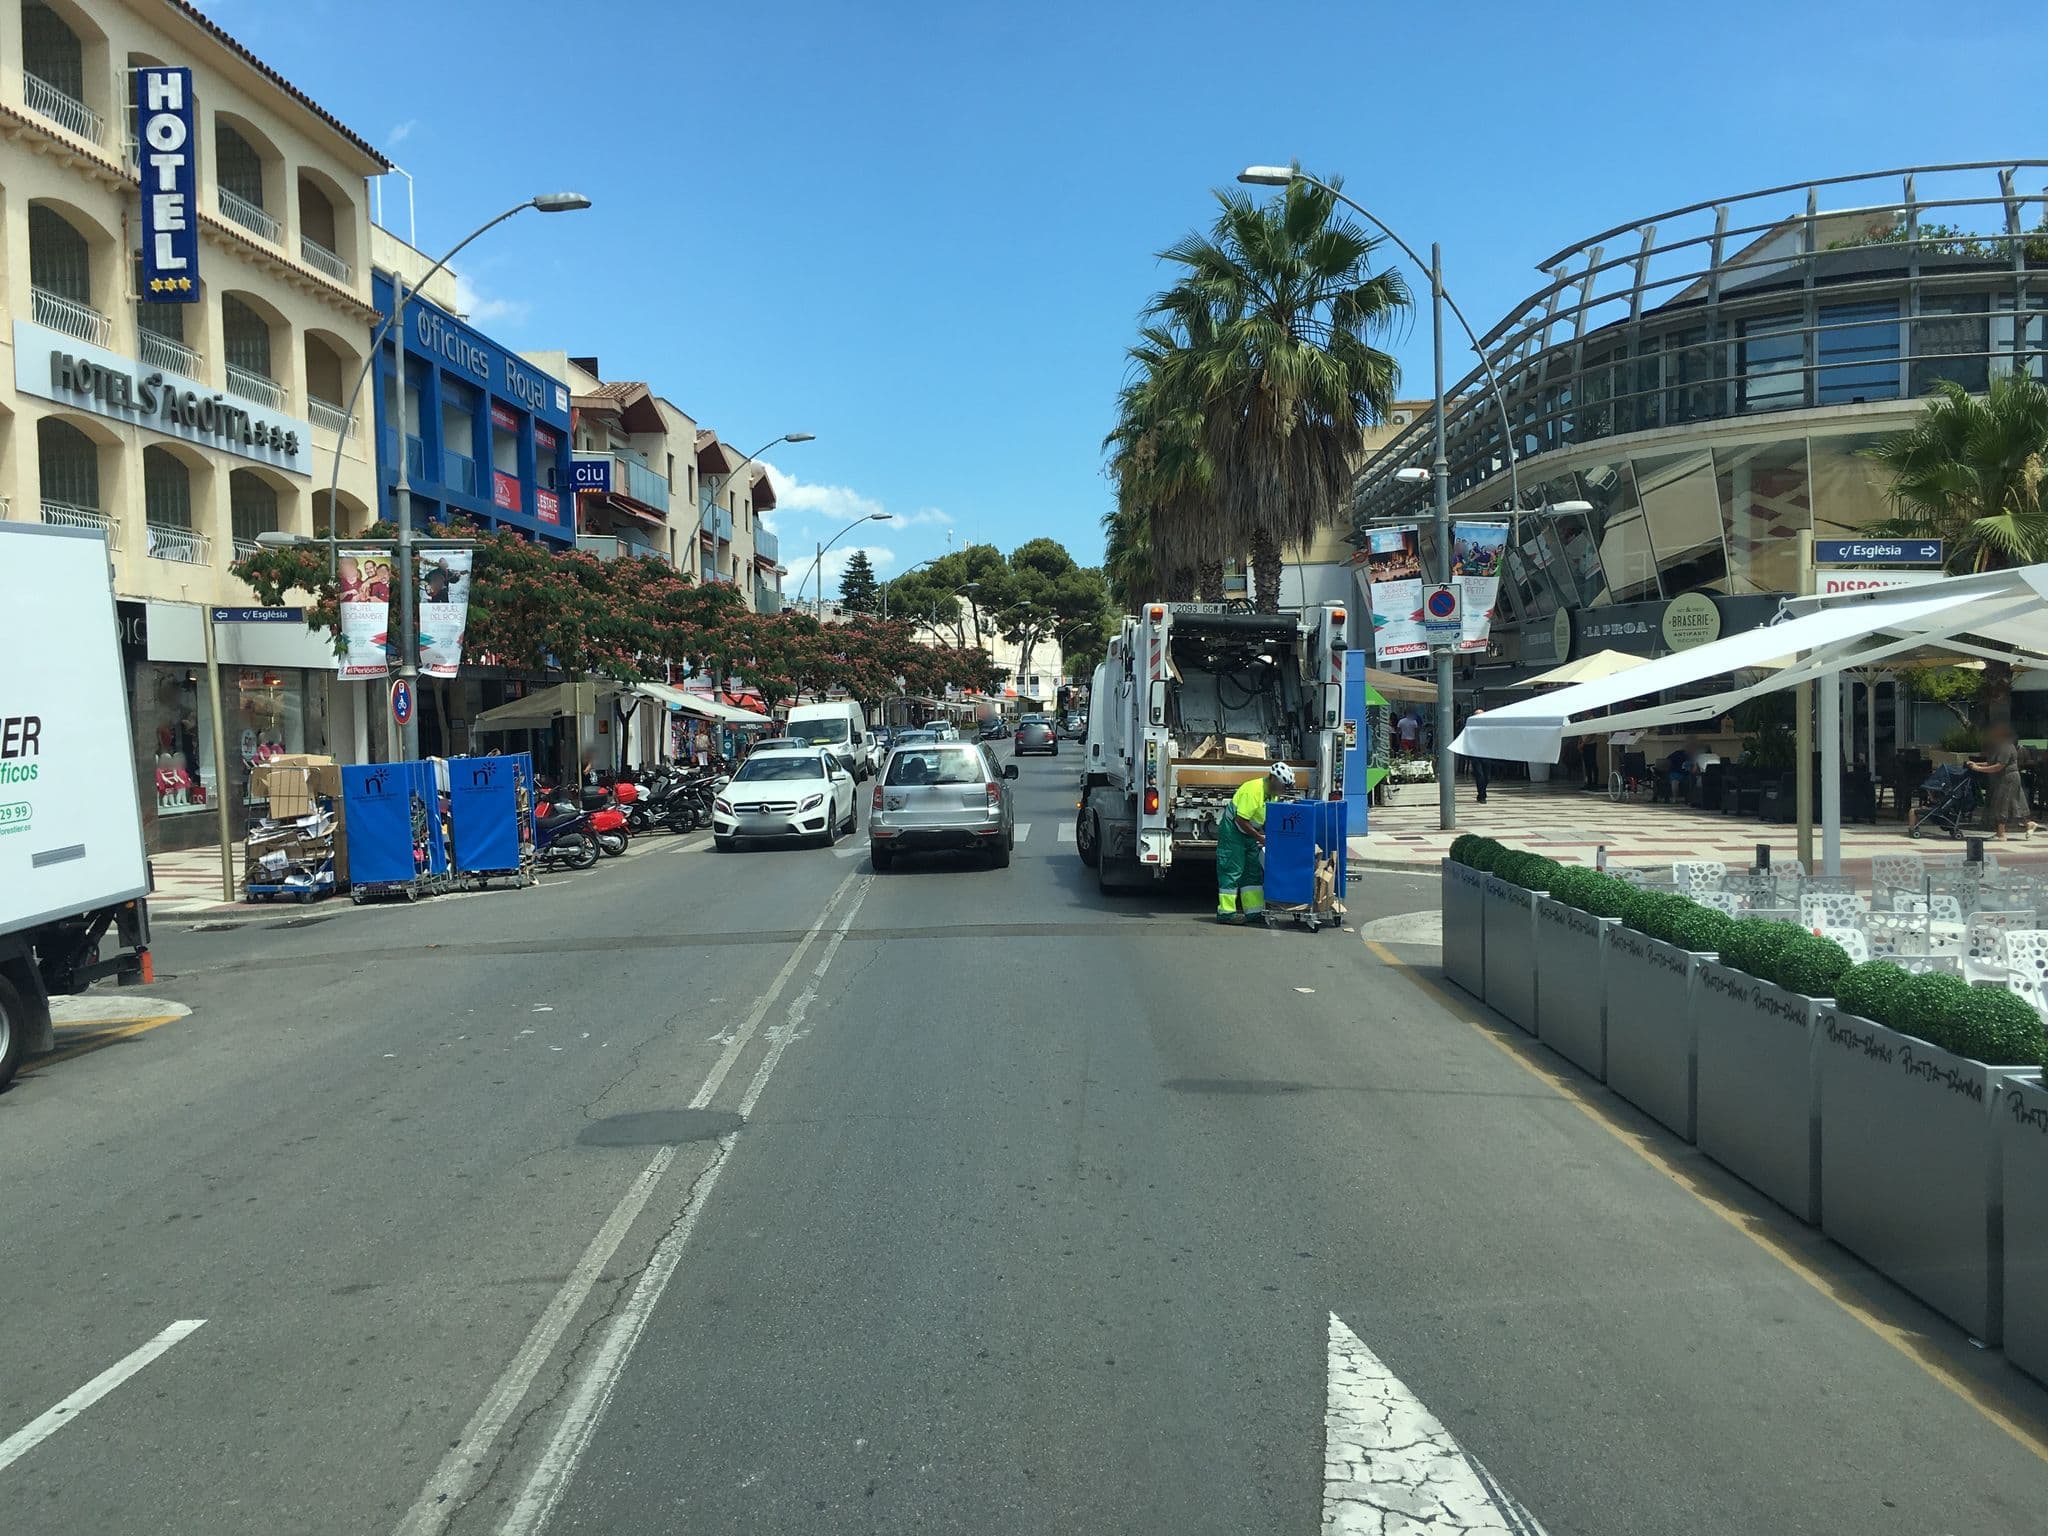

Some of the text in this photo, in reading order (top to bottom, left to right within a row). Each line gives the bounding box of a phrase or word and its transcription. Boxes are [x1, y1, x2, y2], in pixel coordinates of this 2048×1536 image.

[146, 73, 187, 269] HOTEL
[418, 308, 547, 412] Oficines Royal
[51, 351, 143, 411] HOTEL
[1839, 545, 1852, 558] c/
[242, 610, 252, 620] c/
[1175, 604, 1198, 614] 2093
[1672, 614, 1710, 627] BRASERIE
[1602, 621, 1648, 636] PROA
[0, 716, 41, 759] ER
[15, 805, 28, 818] 99
